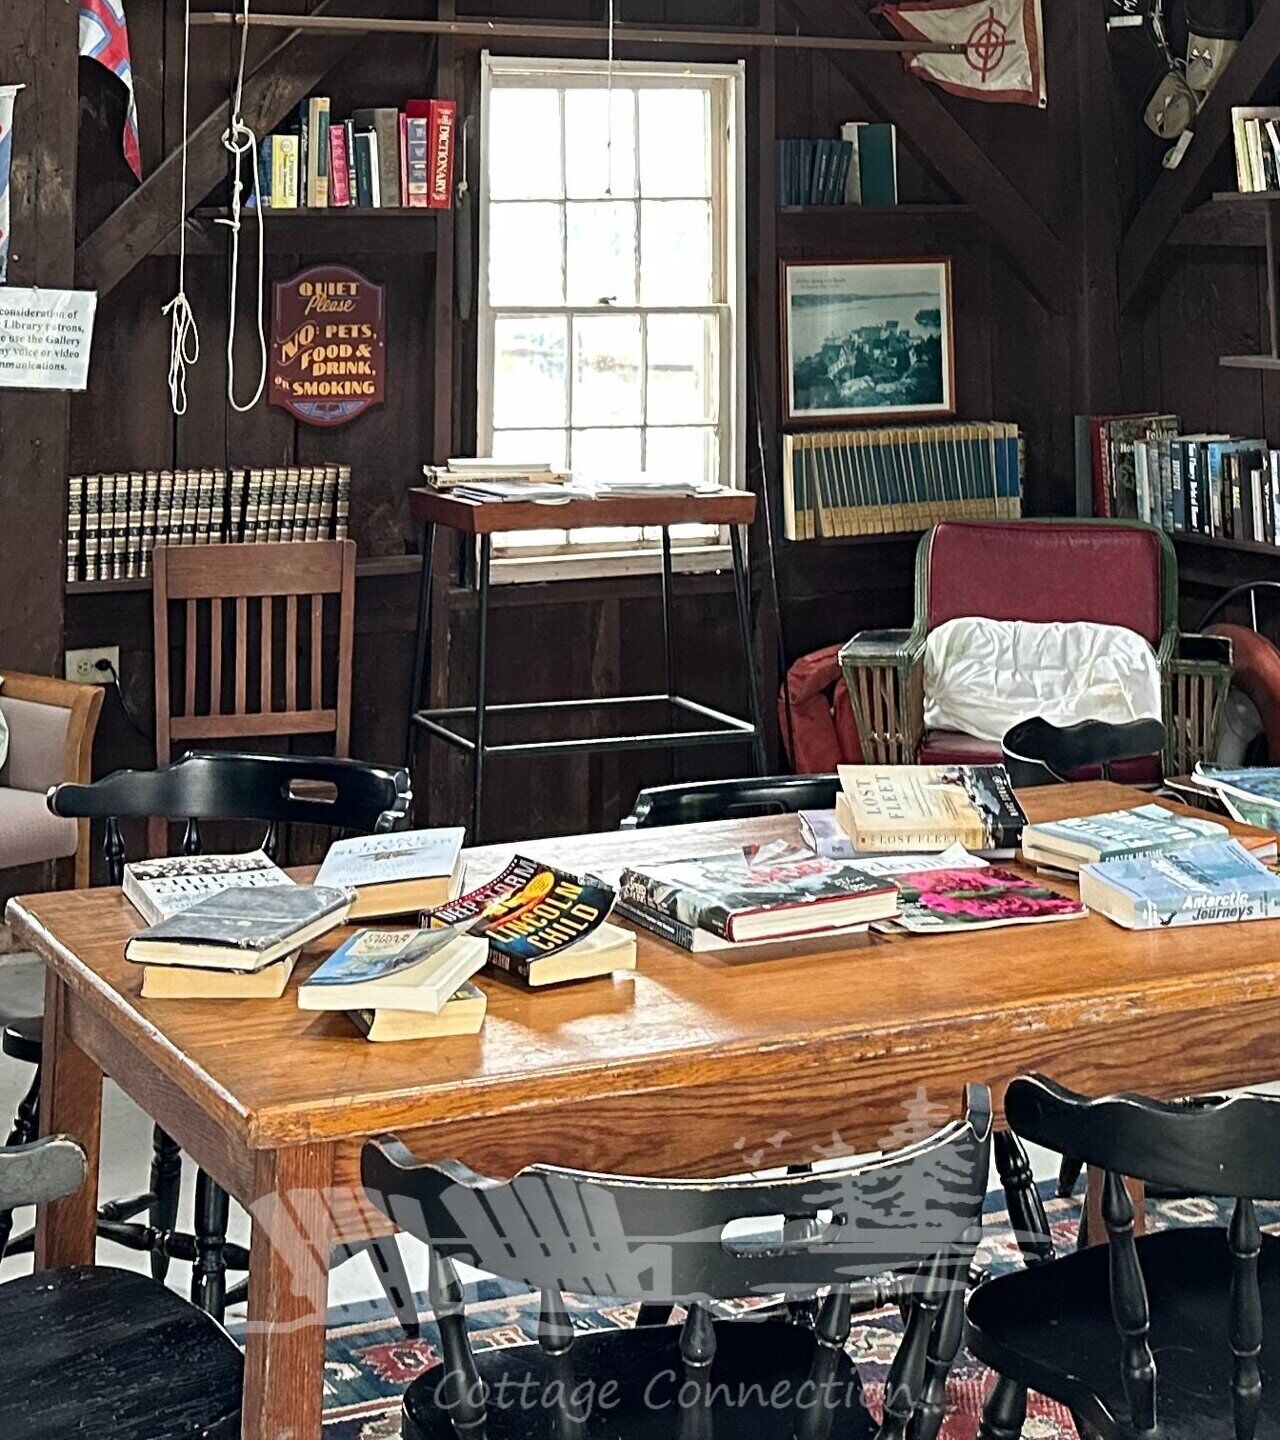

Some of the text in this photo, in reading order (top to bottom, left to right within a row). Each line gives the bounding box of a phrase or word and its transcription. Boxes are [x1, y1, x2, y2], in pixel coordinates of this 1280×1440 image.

[435, 125, 451, 196] DICTIONARY
[299, 282, 360, 298] QUIET
[67, 310, 78, 319] of
[305, 296, 356, 316] Please
[28, 334, 43, 344] the
[46, 335, 80, 347] Gallery
[55, 348, 80, 359] video
[301, 343, 372, 370] FOOD &
[292, 380, 375, 396] SMOKING
[856, 778, 882, 815] LOST
[875, 774, 905, 820] FLEET
[879, 833, 912, 845] LOST
[434, 859, 538, 922] DEEP STORM
[1182, 891, 1250, 910] Antarctic
[485, 881, 584, 944] LINCOLN
[1192, 904, 1254, 922] Journeys
[527, 903, 599, 951] CHILD
